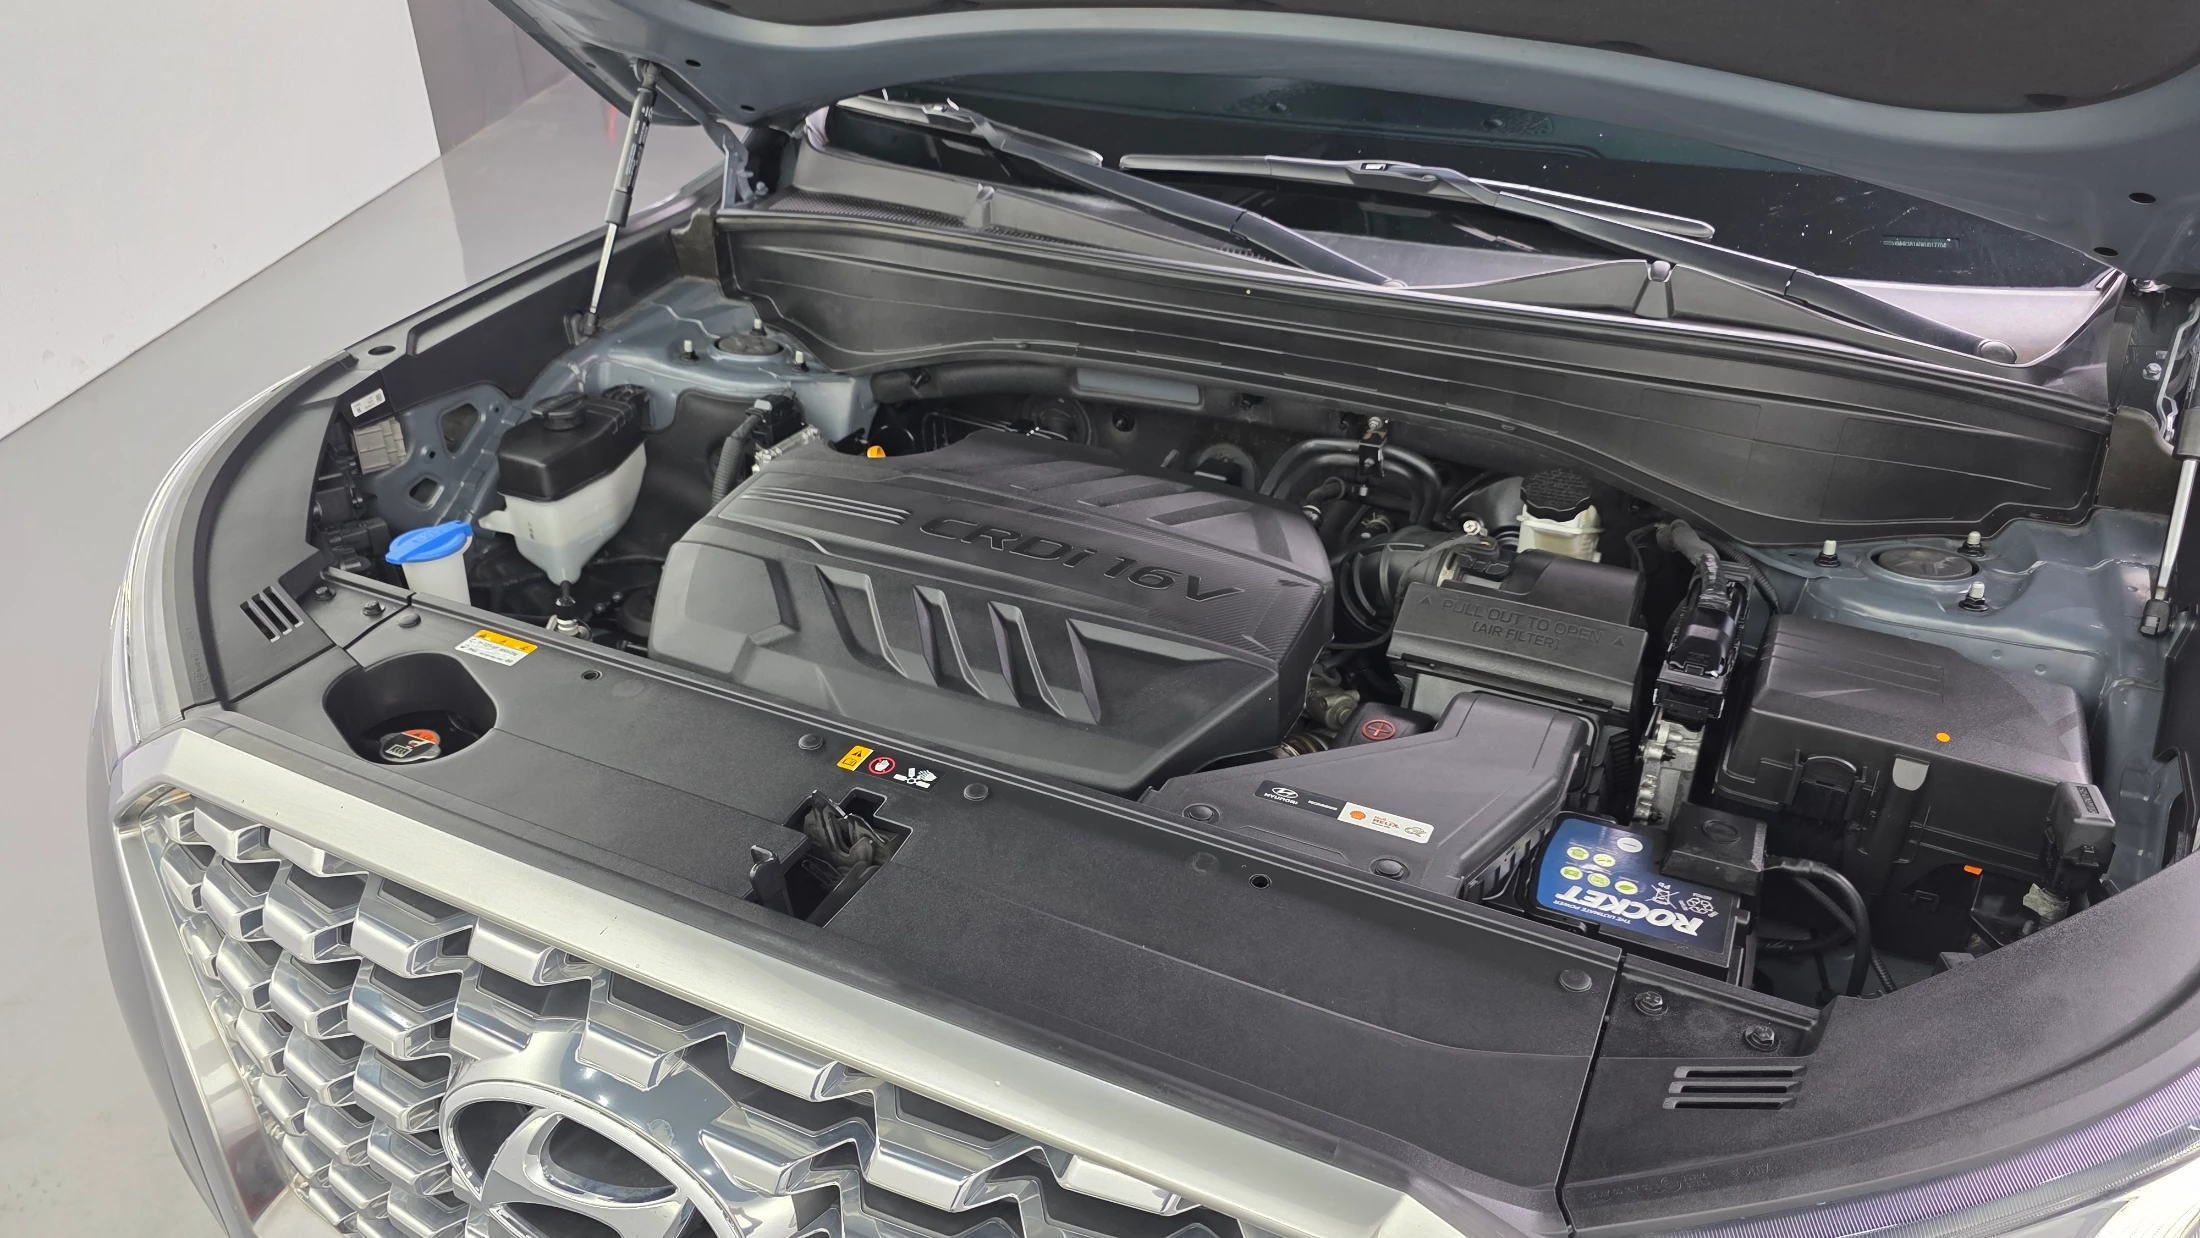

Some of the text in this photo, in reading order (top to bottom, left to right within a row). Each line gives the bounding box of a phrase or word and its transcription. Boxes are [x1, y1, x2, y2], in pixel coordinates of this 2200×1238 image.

[1103, 555, 1246, 602] 16V
[1441, 598, 1603, 644] PULL OUT TO OPEN
[1264, 792, 1299, 805] HYUNDAI
[1552, 899, 1631, 925] THE ULTIMATE POWER
[1555, 885, 1704, 936] ROCKET
